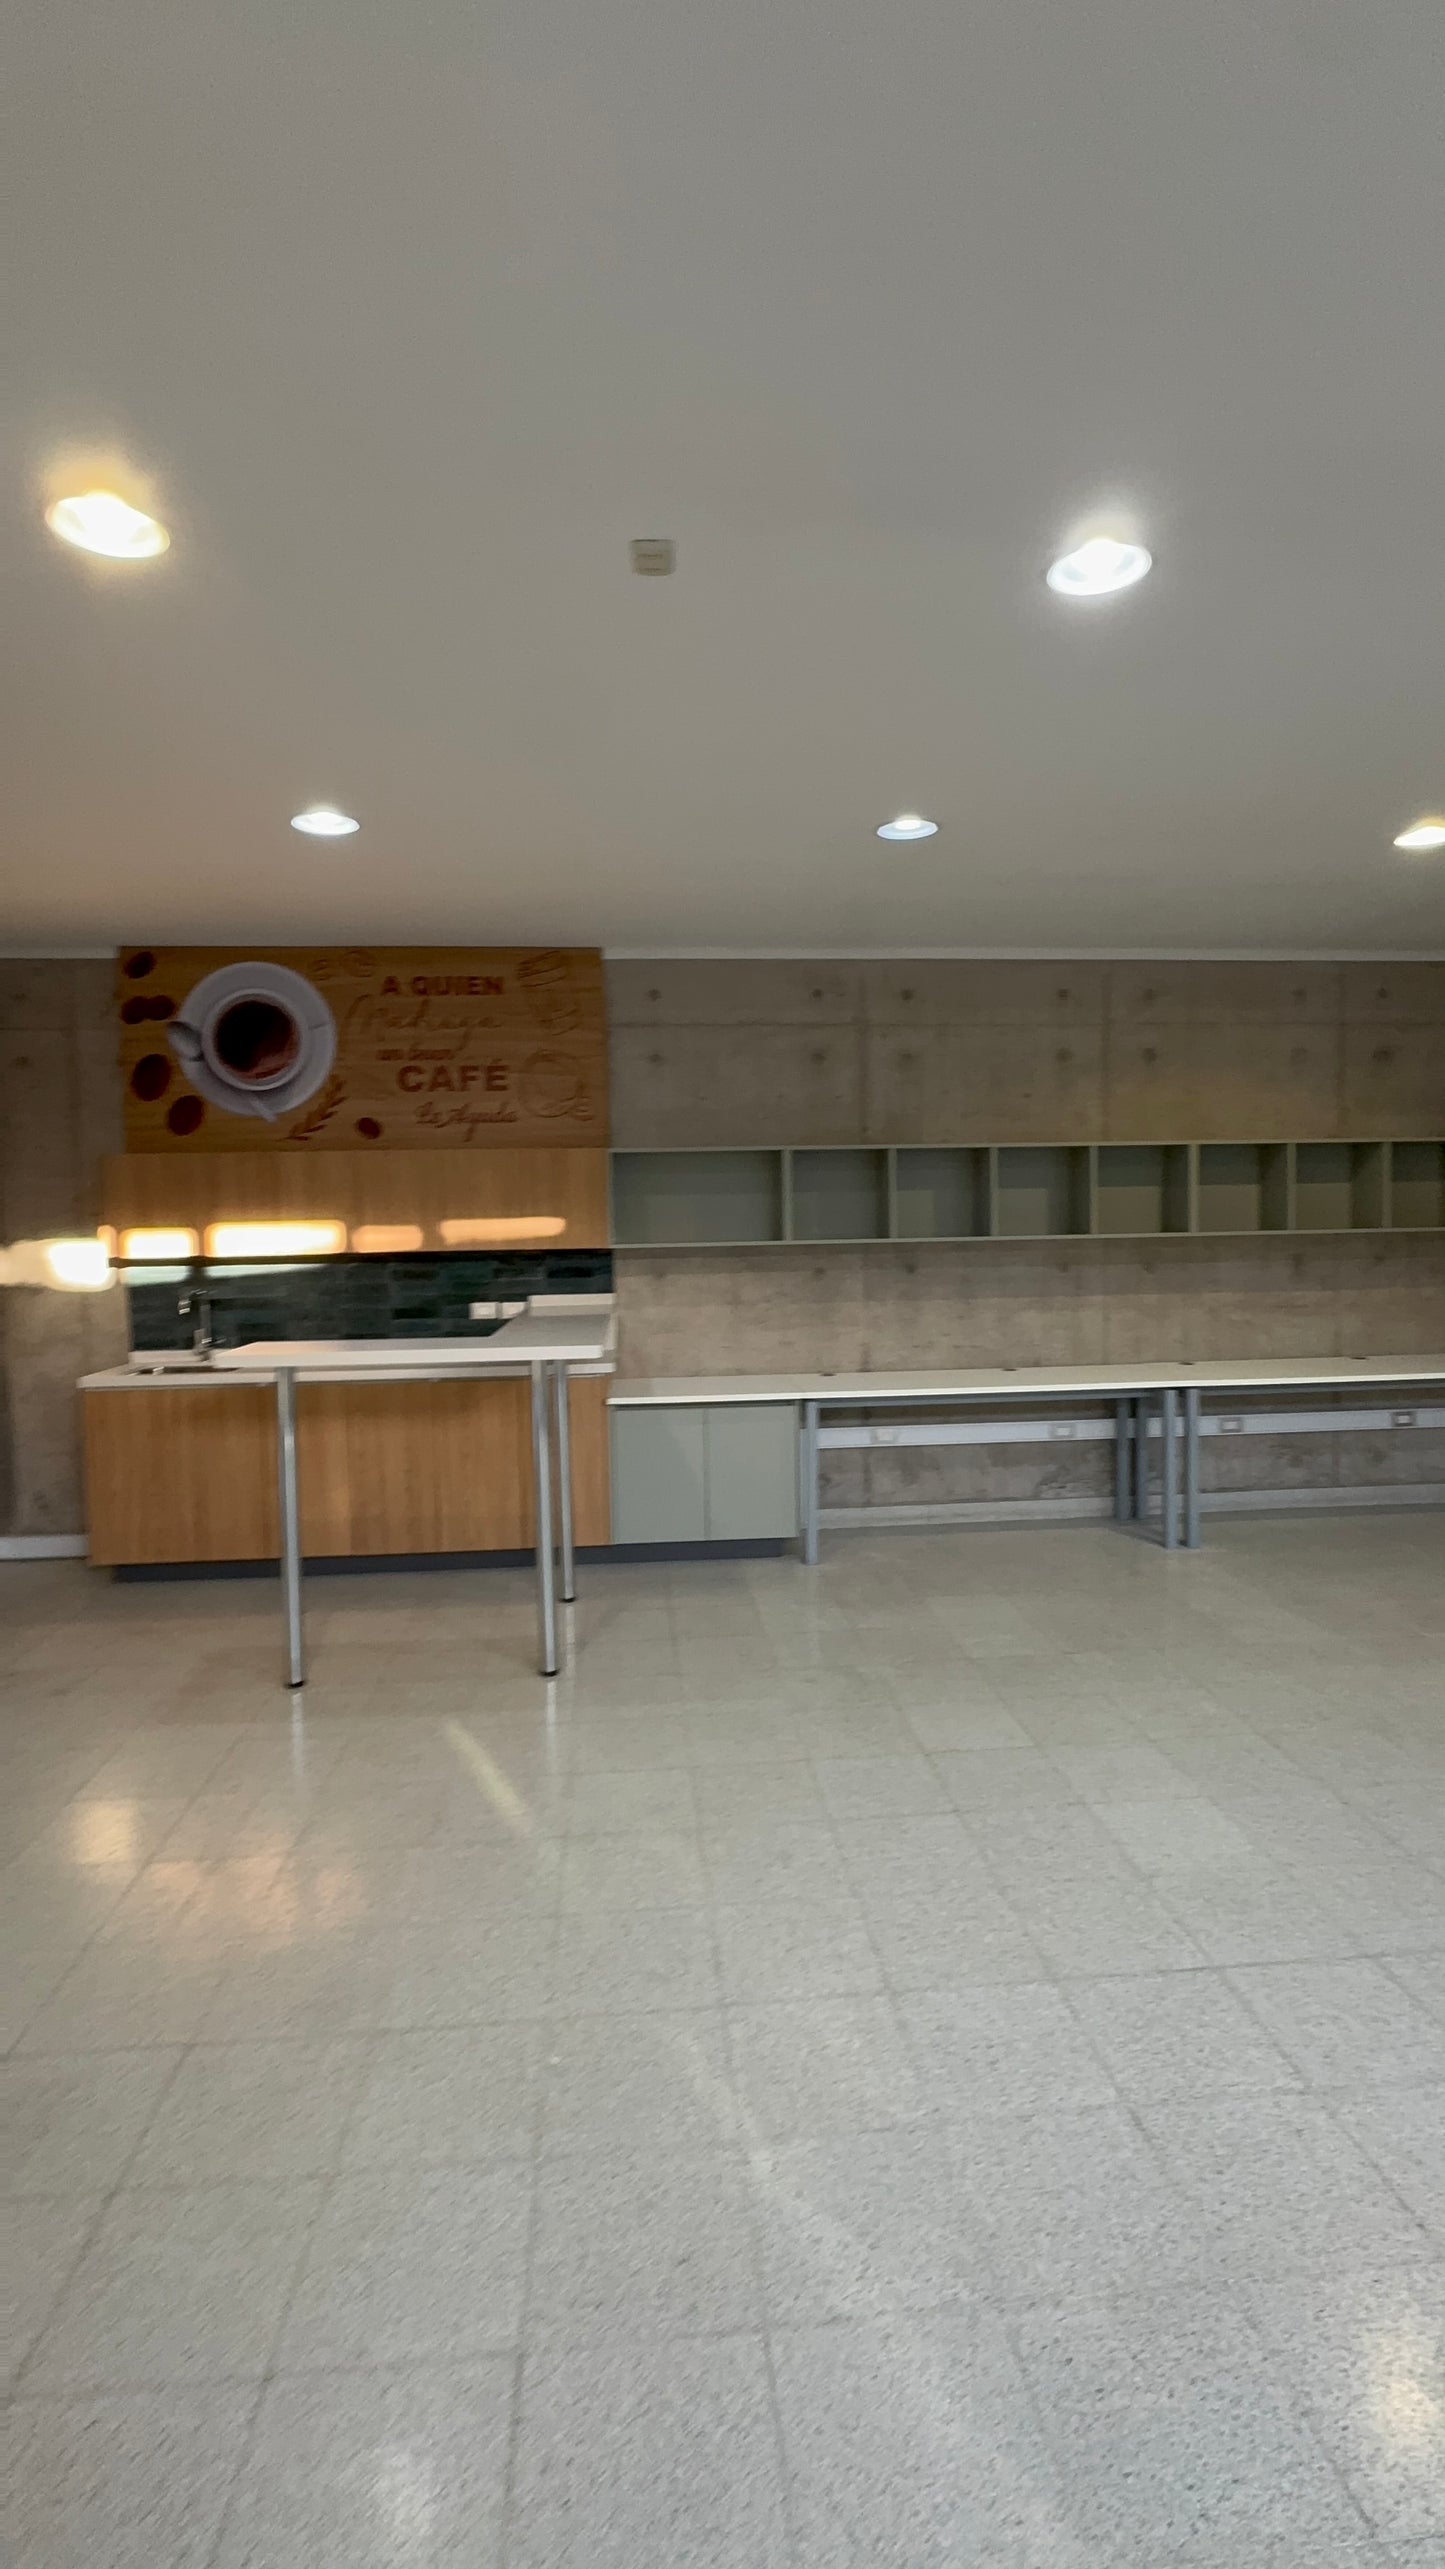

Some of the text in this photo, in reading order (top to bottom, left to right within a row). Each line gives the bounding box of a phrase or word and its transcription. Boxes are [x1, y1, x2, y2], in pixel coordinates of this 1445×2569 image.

[380, 976, 504, 996] A QUIEN
[398, 1059, 510, 1092] CAFÉ
